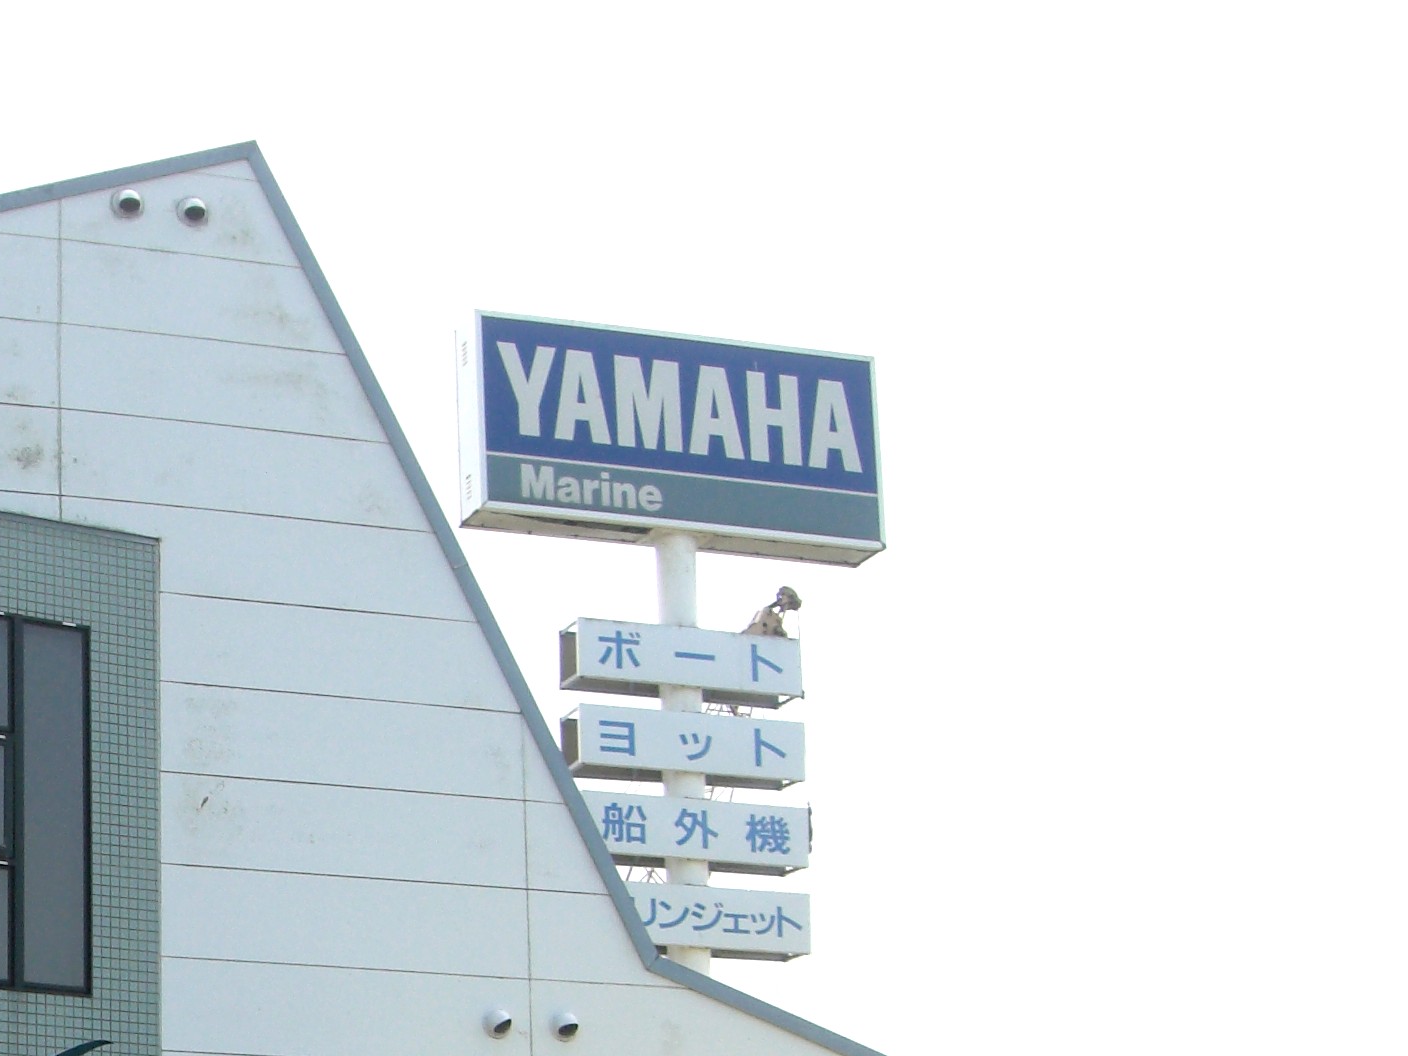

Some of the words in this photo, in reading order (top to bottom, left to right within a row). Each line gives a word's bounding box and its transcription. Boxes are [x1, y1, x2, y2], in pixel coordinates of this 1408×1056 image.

[496, 340, 863, 473] YAMAHA
[520, 463, 663, 511] Marine
[597, 629, 783, 682] ボート
[598, 719, 786, 767] ヨット
[602, 802, 790, 855] 船外機
